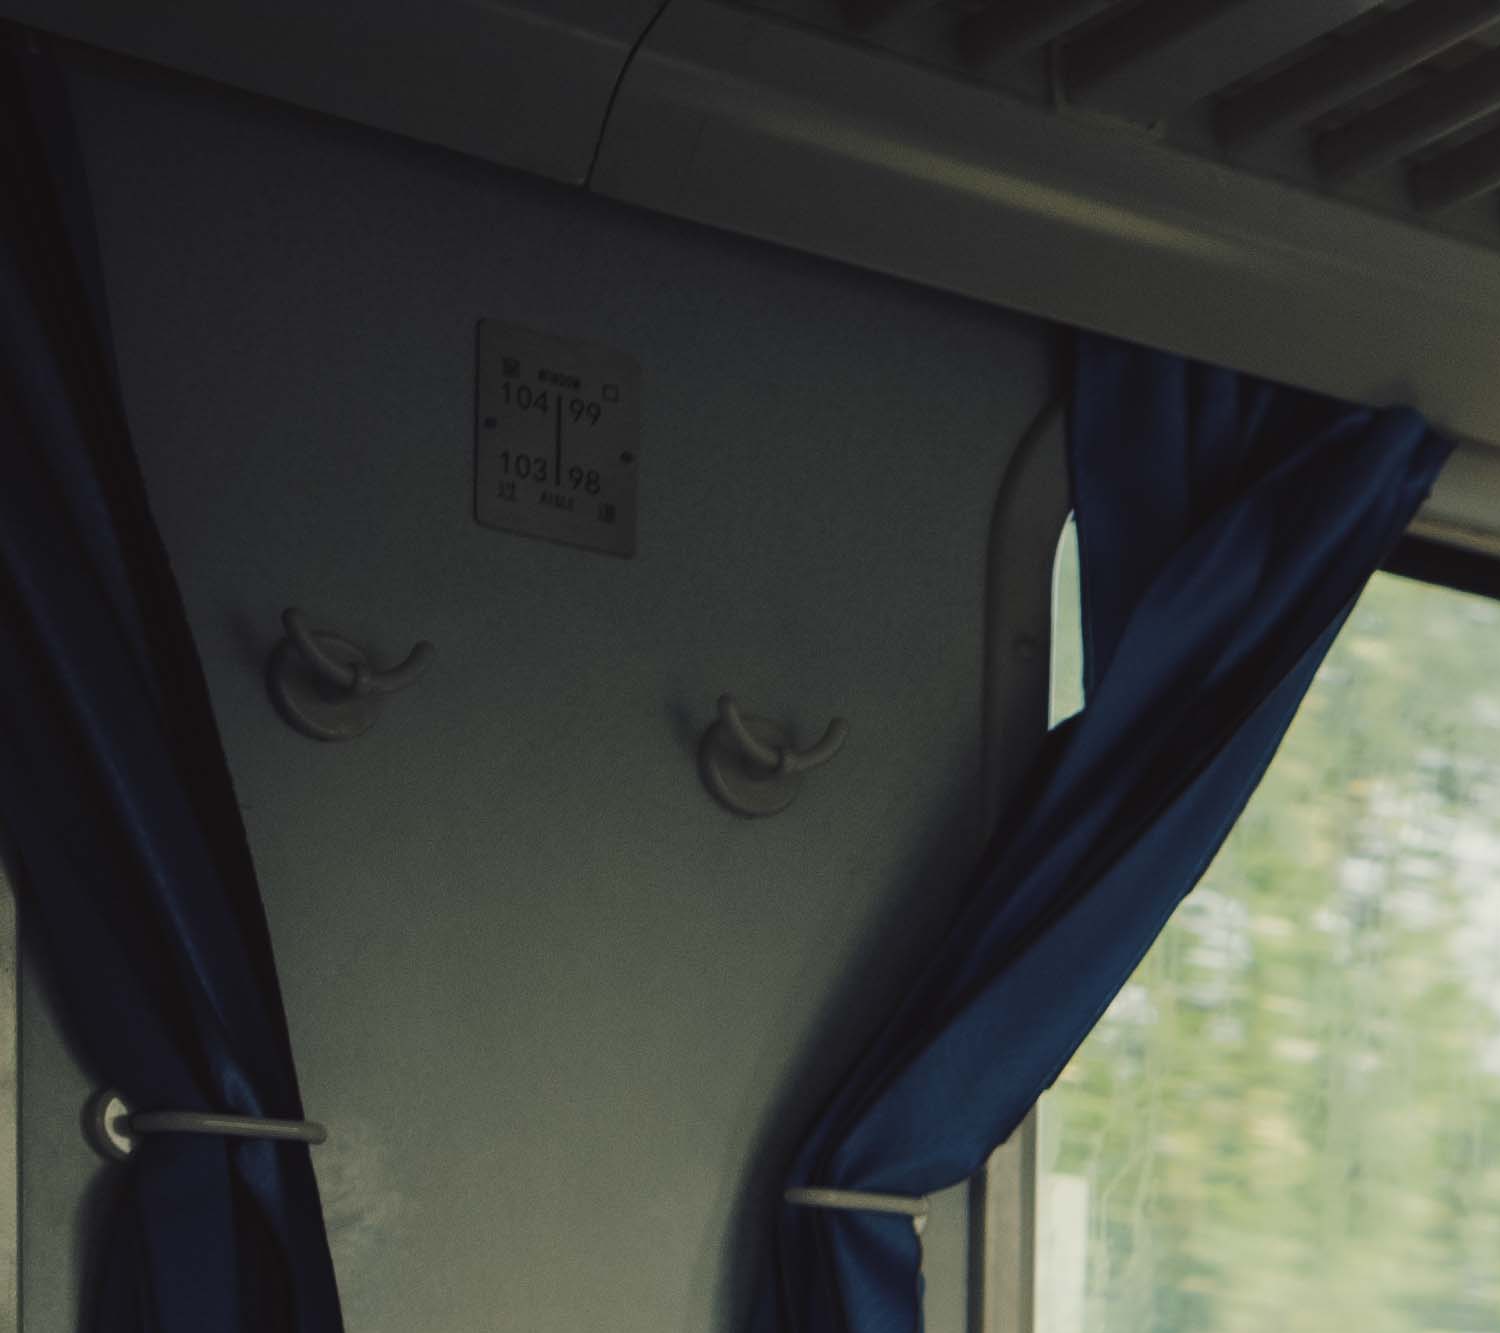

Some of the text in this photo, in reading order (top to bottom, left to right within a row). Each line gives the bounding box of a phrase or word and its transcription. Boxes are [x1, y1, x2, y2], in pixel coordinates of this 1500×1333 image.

[501, 381, 602, 425] 104 99
[499, 450, 601, 495] 103 98
